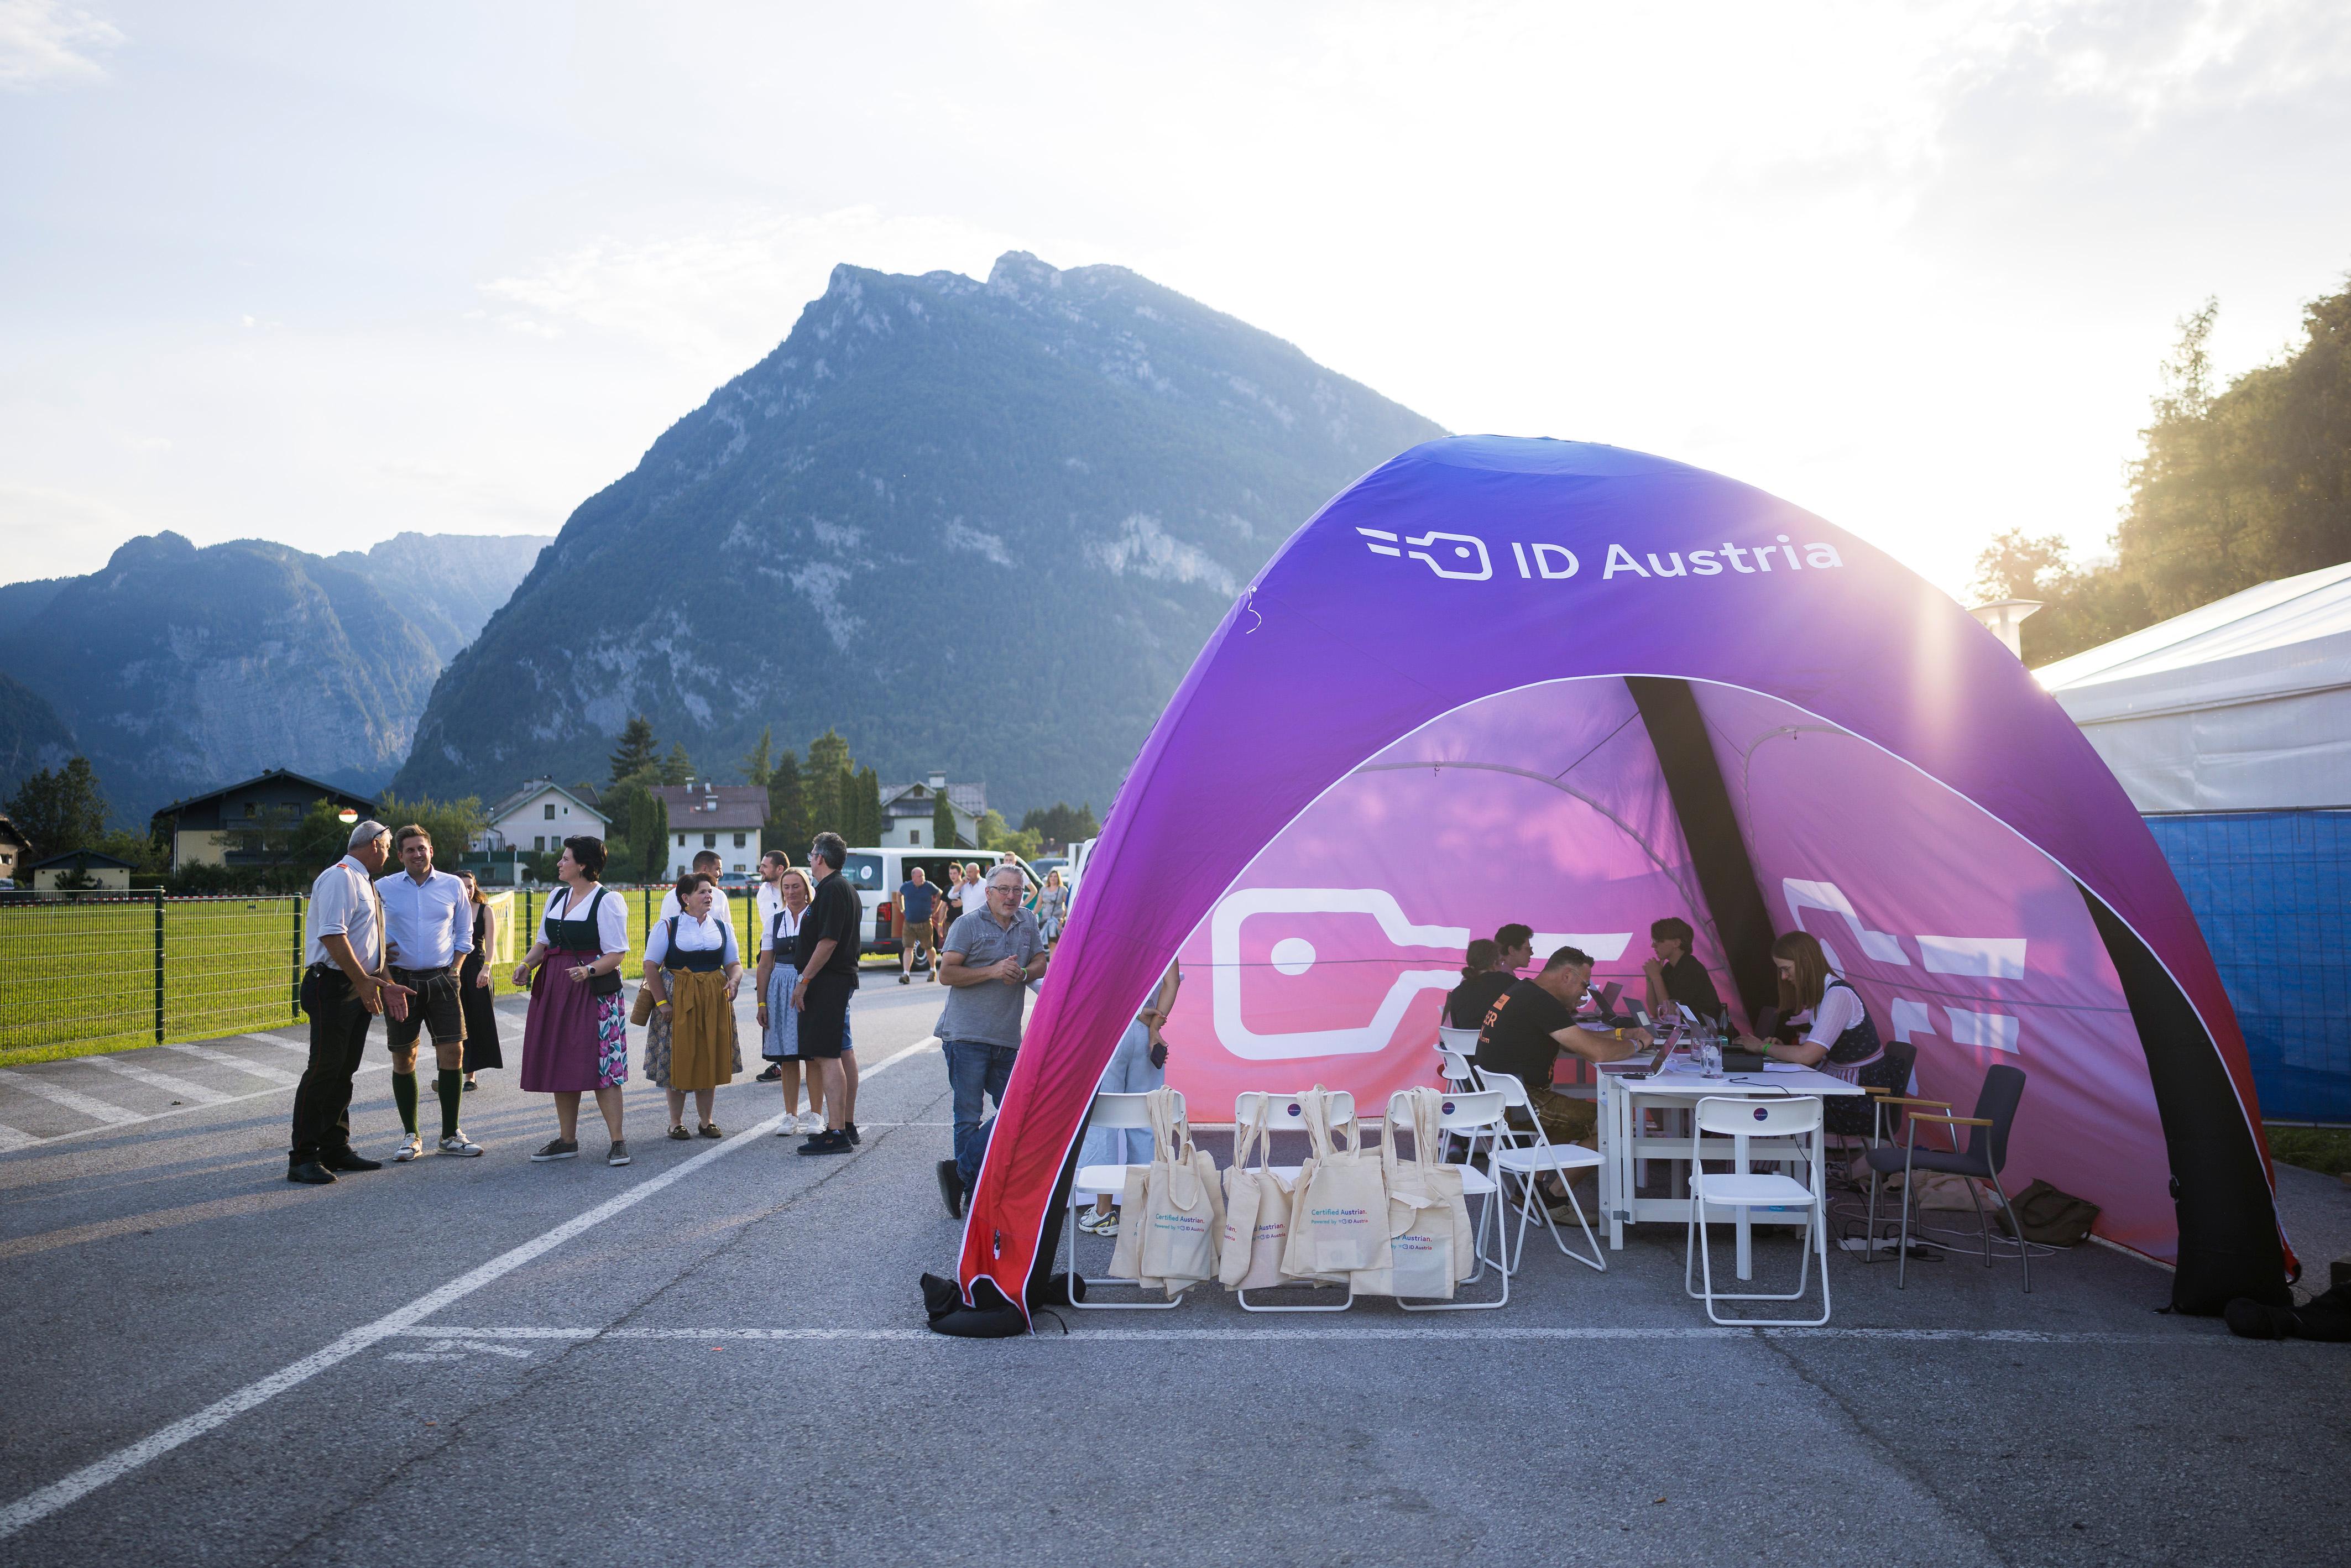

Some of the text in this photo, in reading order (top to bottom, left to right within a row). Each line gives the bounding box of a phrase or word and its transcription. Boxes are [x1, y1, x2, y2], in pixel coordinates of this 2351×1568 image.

[1511, 534, 1844, 580] ID Austria
[1156, 1213, 1179, 1221] Certified
